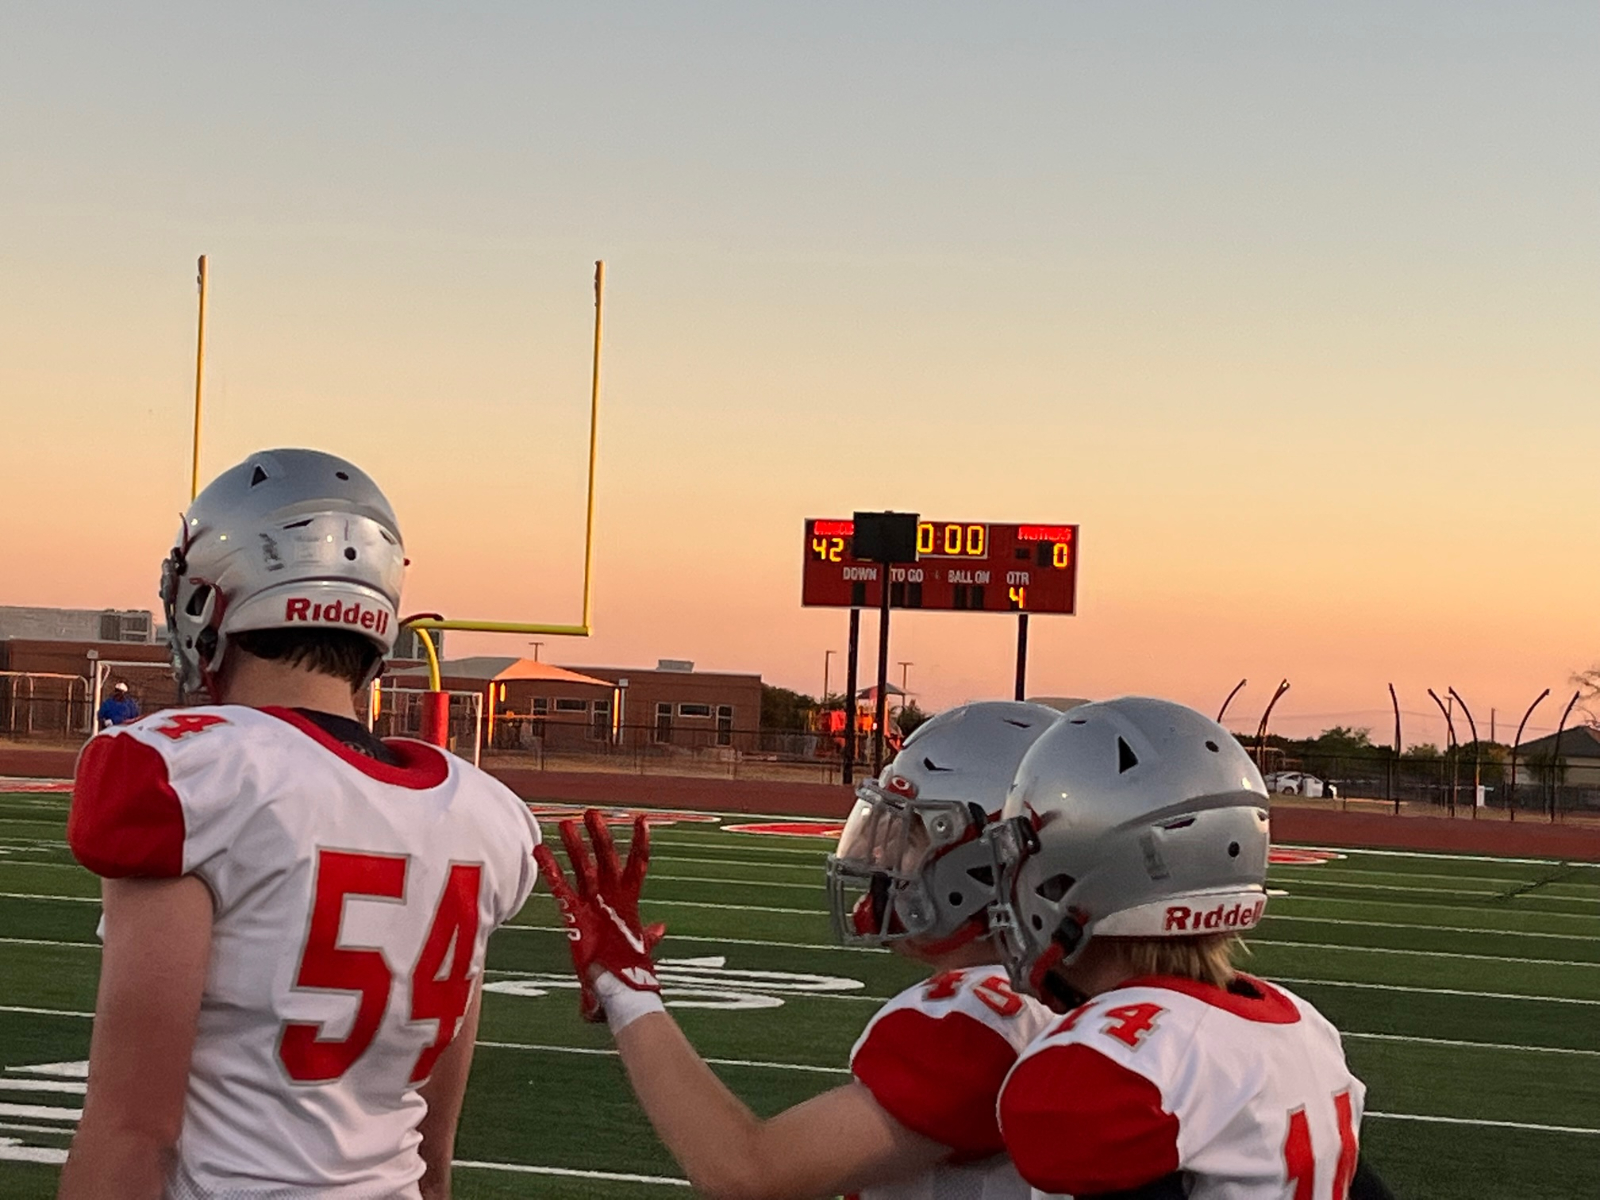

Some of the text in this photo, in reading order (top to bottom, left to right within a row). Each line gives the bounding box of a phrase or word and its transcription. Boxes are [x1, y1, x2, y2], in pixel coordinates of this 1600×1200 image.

[812, 537, 845, 562] 42
[1052, 543, 1068, 568] 0
[843, 566, 877, 581] DOWN
[890, 568, 924, 583] TO GO
[947, 569, 990, 584] BALL ON
[1006, 571, 1030, 586] QTR
[1009, 586, 1025, 609] 4
[285, 597, 389, 635] Riddell
[273, 844, 485, 1088] 54
